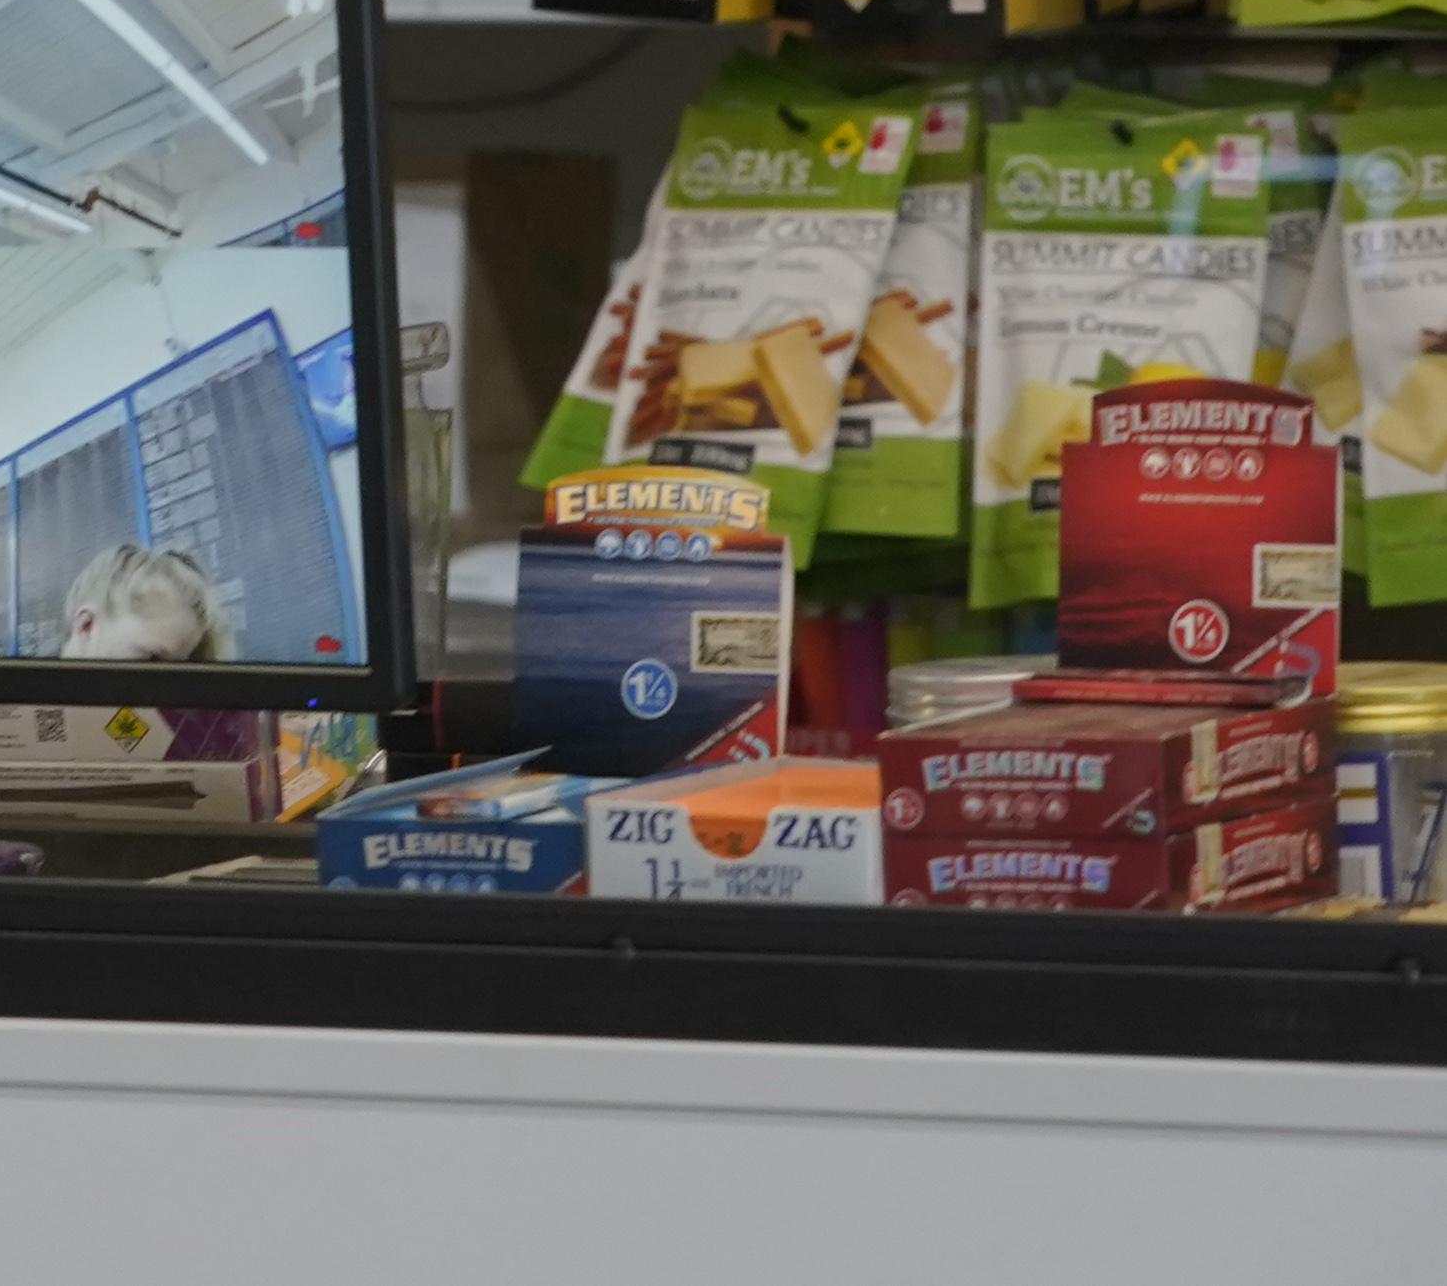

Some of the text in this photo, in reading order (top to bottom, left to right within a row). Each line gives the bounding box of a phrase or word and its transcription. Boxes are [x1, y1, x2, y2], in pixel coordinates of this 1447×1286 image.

[1059, 168, 1153, 210] EM's
[1097, 400, 1312, 447] ELEMENTS
[554, 480, 770, 529] ELEMENTS
[920, 750, 1113, 793] ELEMENTS
[363, 831, 536, 873] ELEMENTS
[604, 810, 858, 851] ZIG ZAG
[927, 851, 1119, 894] ELEMENTS
